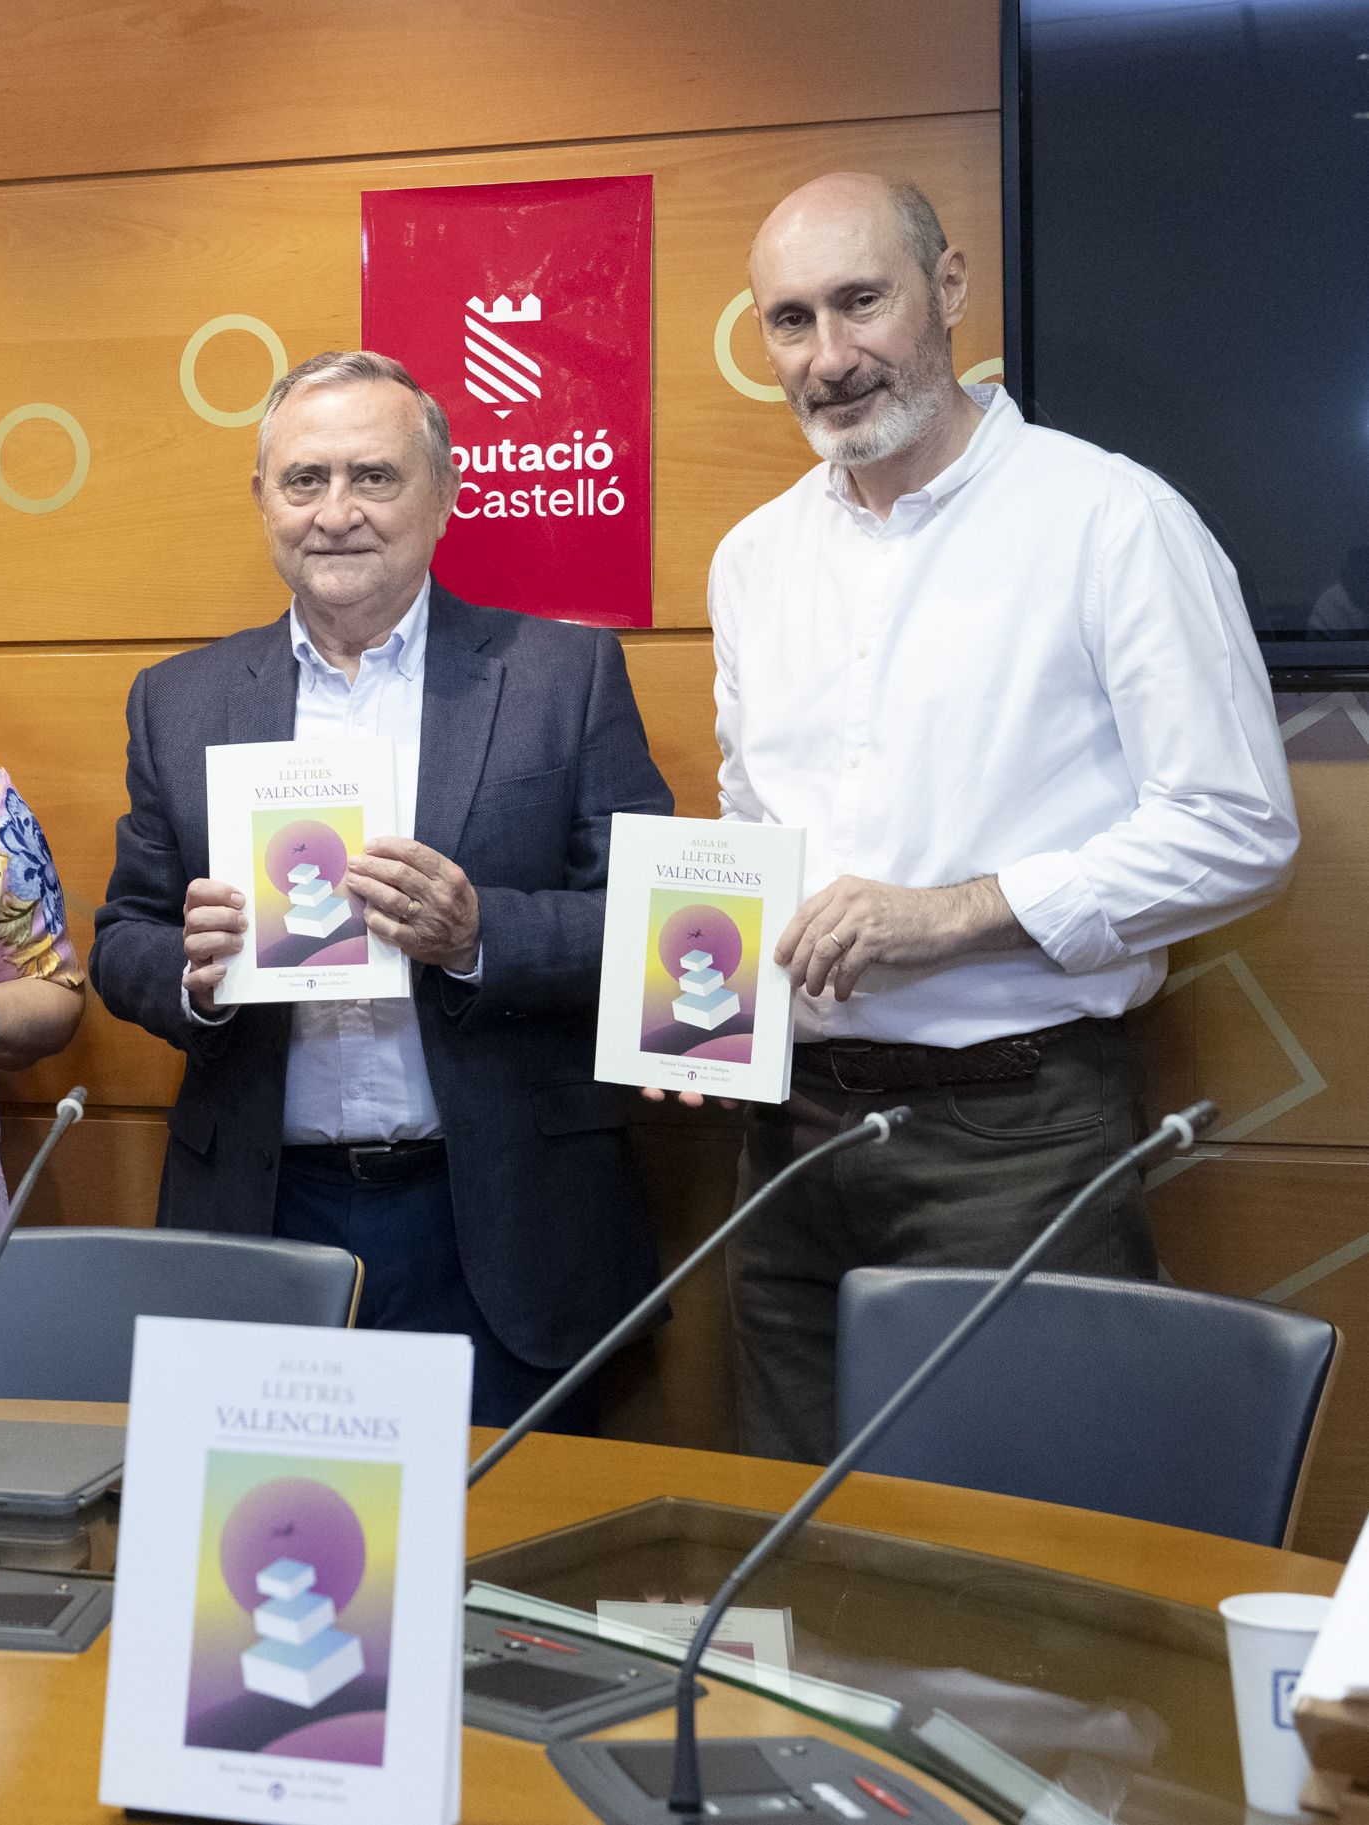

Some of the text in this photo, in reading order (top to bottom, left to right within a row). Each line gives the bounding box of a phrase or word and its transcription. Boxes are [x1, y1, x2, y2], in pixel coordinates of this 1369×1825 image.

[452, 475, 625, 519] Castelló
[279, 769, 333, 781] LLETRES
[255, 783, 359, 800] VALENCIANES
[691, 839, 728, 849] AULA DE
[682, 851, 736, 865] LLETRES
[656, 864, 762, 886] VALENCIANES
[261, 1380, 356, 1405] LLETRES
[215, 1405, 400, 1441] VALENCIANES
